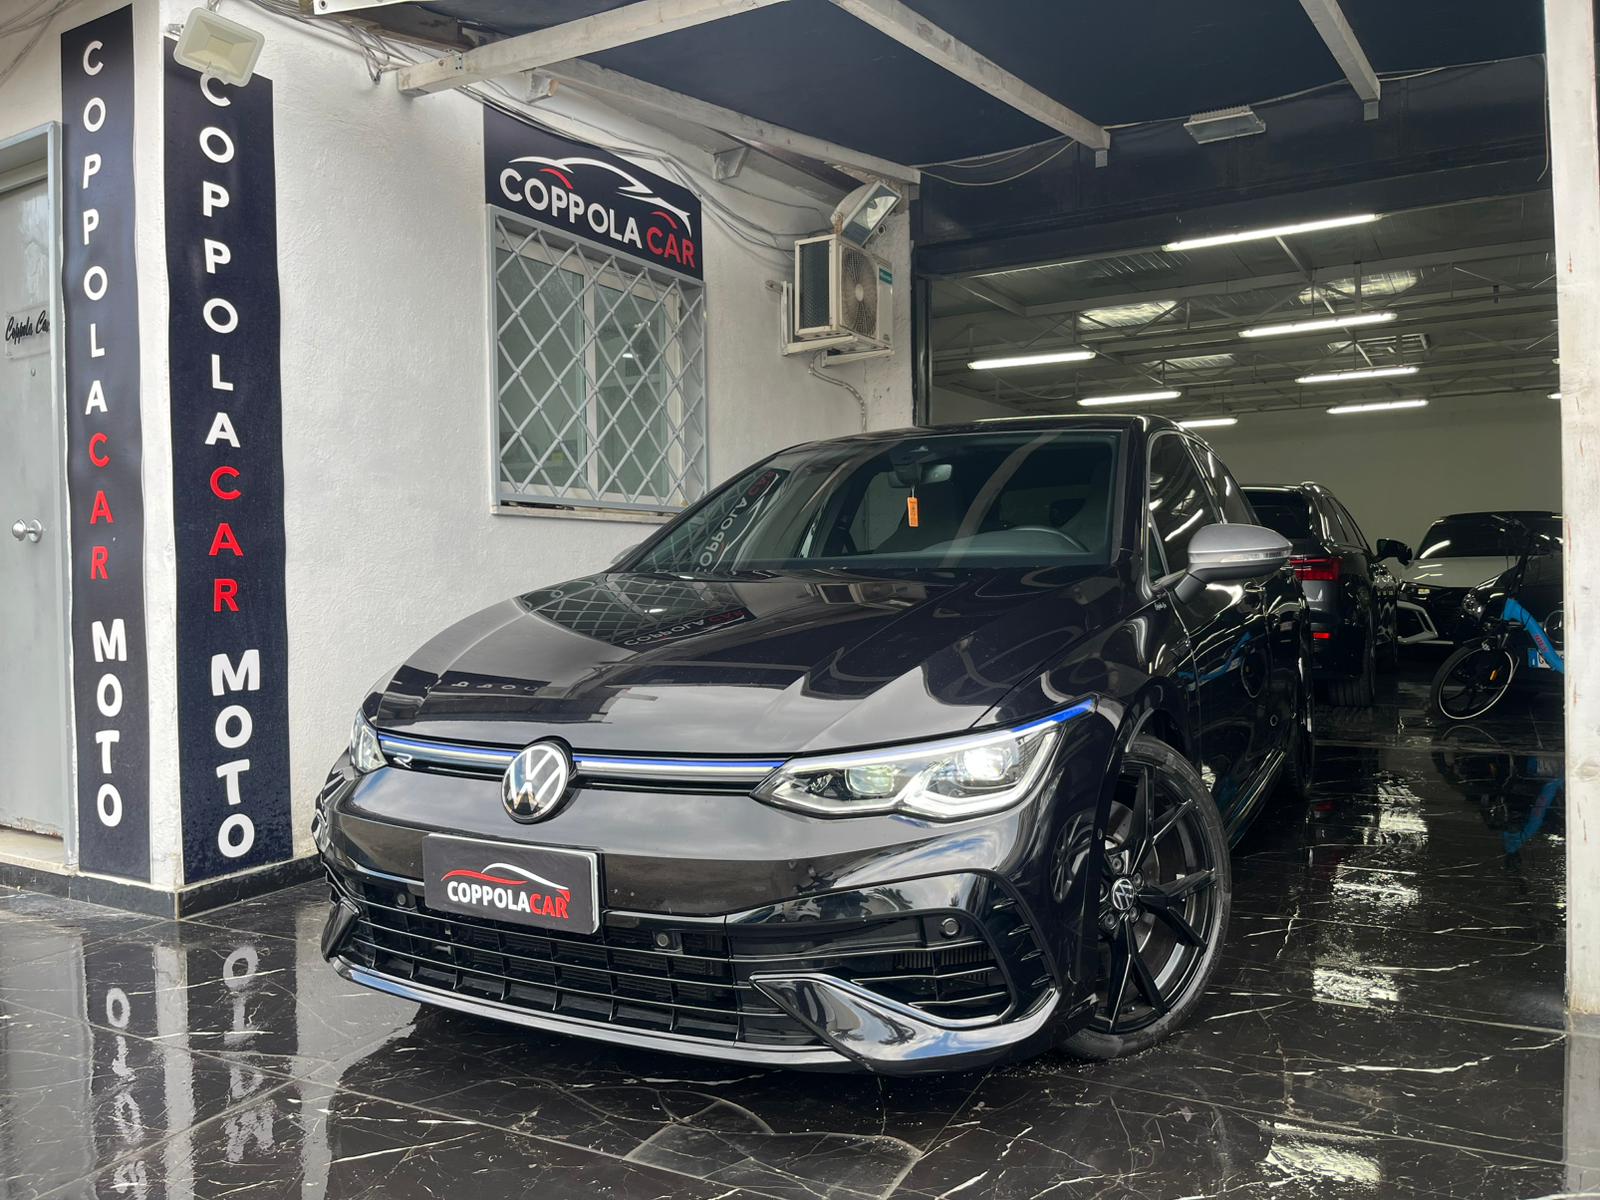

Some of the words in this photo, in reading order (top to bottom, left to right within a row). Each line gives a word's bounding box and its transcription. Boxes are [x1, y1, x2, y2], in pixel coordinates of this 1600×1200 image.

[82, 40, 109, 416] COPPOLA
[199, 75, 241, 448] COPPOLA
[499, 167, 643, 249] COPPOLA
[646, 226, 696, 269] CAR
[88, 432, 114, 580] CAR
[208, 465, 244, 613] CAR
[91, 618, 128, 828] MOTO
[210, 648, 261, 858] MOTO
